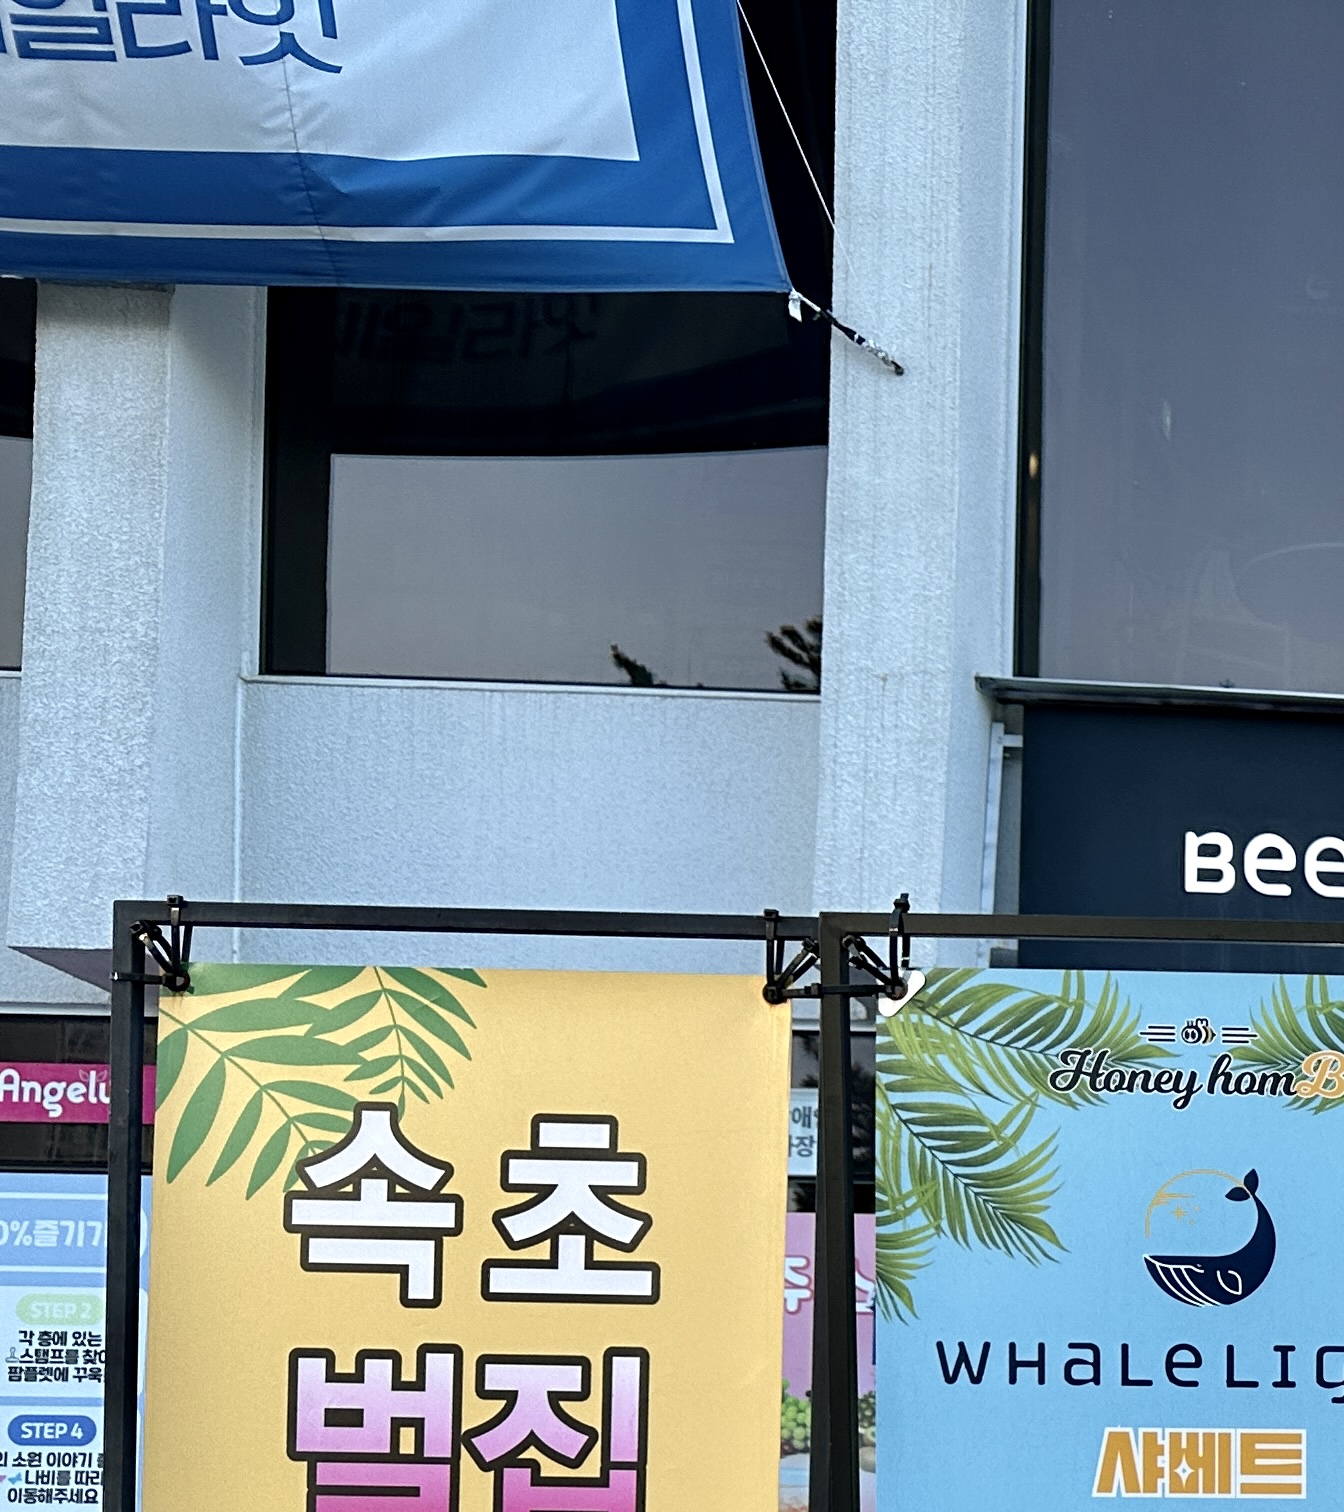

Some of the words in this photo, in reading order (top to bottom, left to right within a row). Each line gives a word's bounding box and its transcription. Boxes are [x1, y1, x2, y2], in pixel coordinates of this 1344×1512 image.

[1048, 1048, 1204, 1110] Honey
[284, 1101, 660, 1308] 속초
[30, 1302, 77, 1319] STEP
[80, 1303, 91, 1319] 2
[18, 1330, 34, 1346] 각
[37, 1330, 67, 1347] 층에
[72, 1331, 102, 1347] 있는
[19, 1348, 78, 1364] 스탬프를
[21, 1422, 67, 1439] STEP
[70, 1422, 83, 1439] 4
[12, 1451, 42, 1467] 소원
[46, 1452, 92, 1468] 이야기
[1093, 1427, 1307, 1499] 샤베트
[25, 1470, 70, 1486] 나비를
[7, 1488, 98, 1504] 이동해주세요
